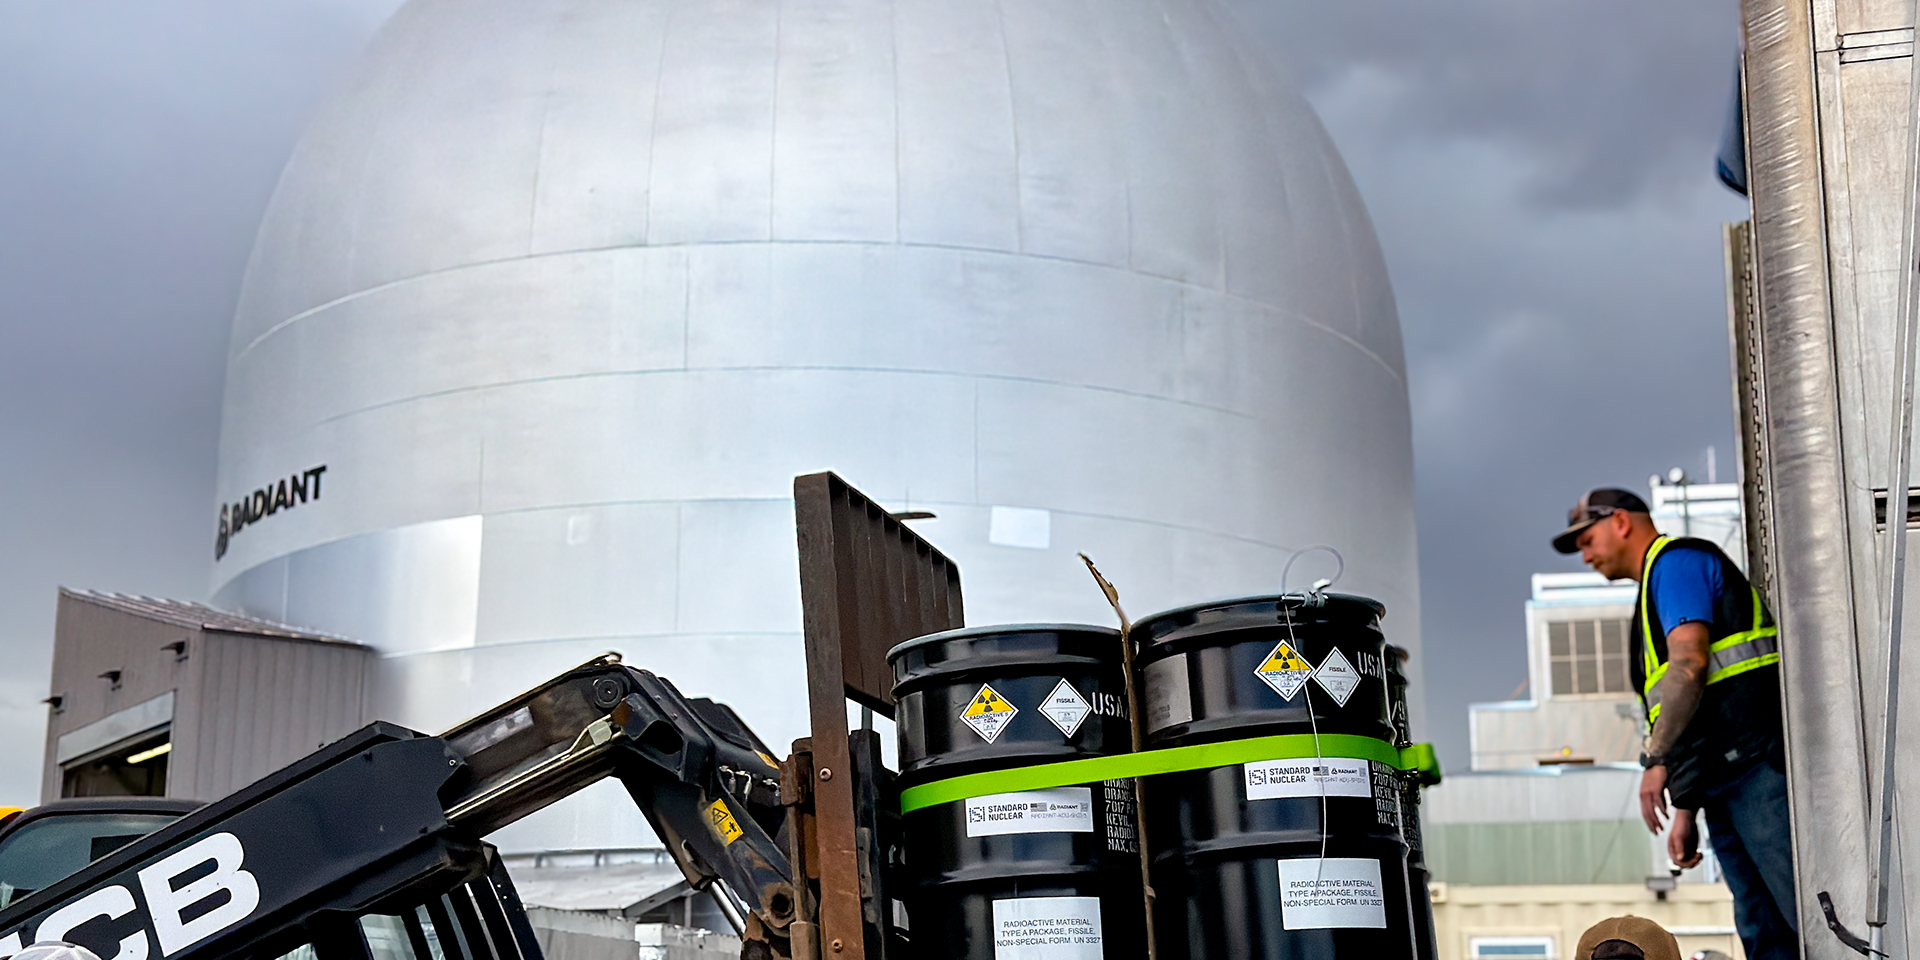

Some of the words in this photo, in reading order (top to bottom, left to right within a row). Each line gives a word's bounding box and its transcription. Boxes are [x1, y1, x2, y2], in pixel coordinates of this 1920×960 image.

[230, 465, 327, 537] RADIANT
[1269, 766, 1310, 776] STANDARD
[1270, 775, 1306, 784] NUCLEAR
[988, 803, 1028, 813] STANDARD
[988, 812, 1024, 821] NUCLEAR
[1290, 880, 1341, 888] RADIOACTIVE
[0, 832, 260, 960] CB
[1288, 890, 1308, 898] TYPE
[1283, 899, 1335, 907] NON-SPECIAL
[1003, 919, 1054, 928] RADIOACTIVE
[996, 938, 1047, 947] NON-SPECIAL
